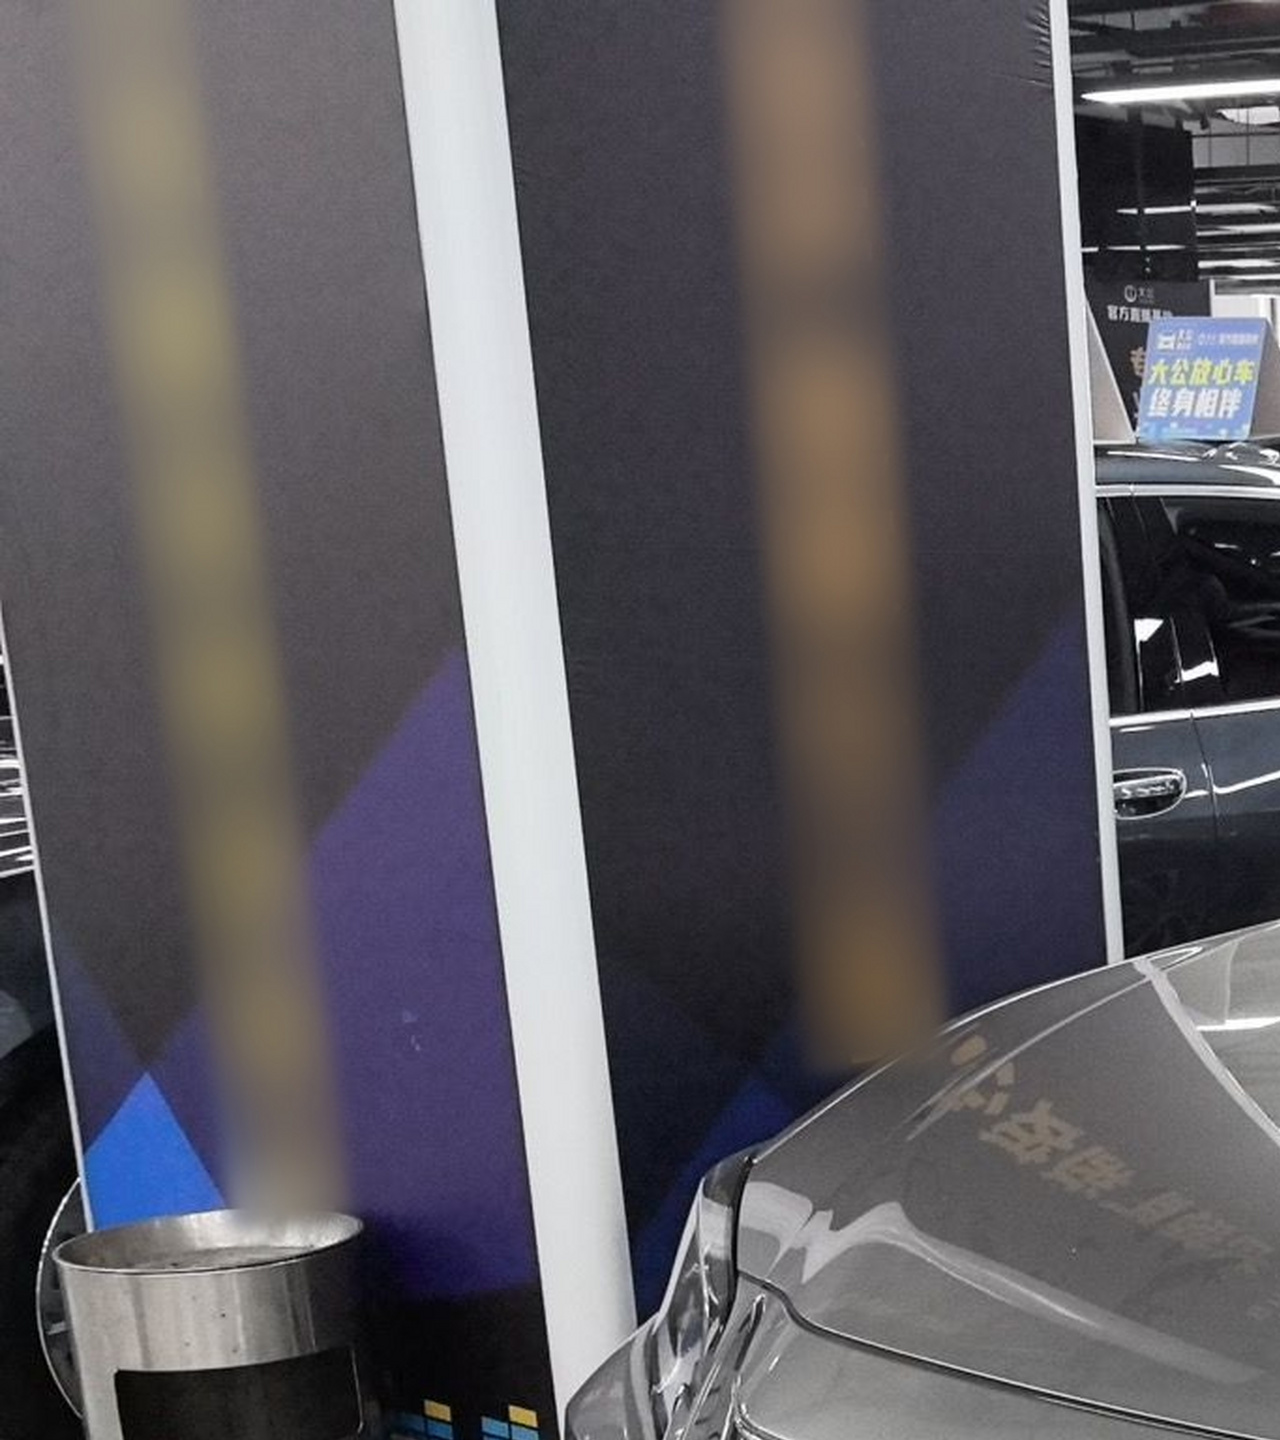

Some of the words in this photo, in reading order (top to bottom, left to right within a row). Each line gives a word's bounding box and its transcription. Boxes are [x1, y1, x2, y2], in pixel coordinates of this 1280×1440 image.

[1148, 356, 1256, 386] 大公放心车
[1147, 387, 1243, 419] 终身相伴
